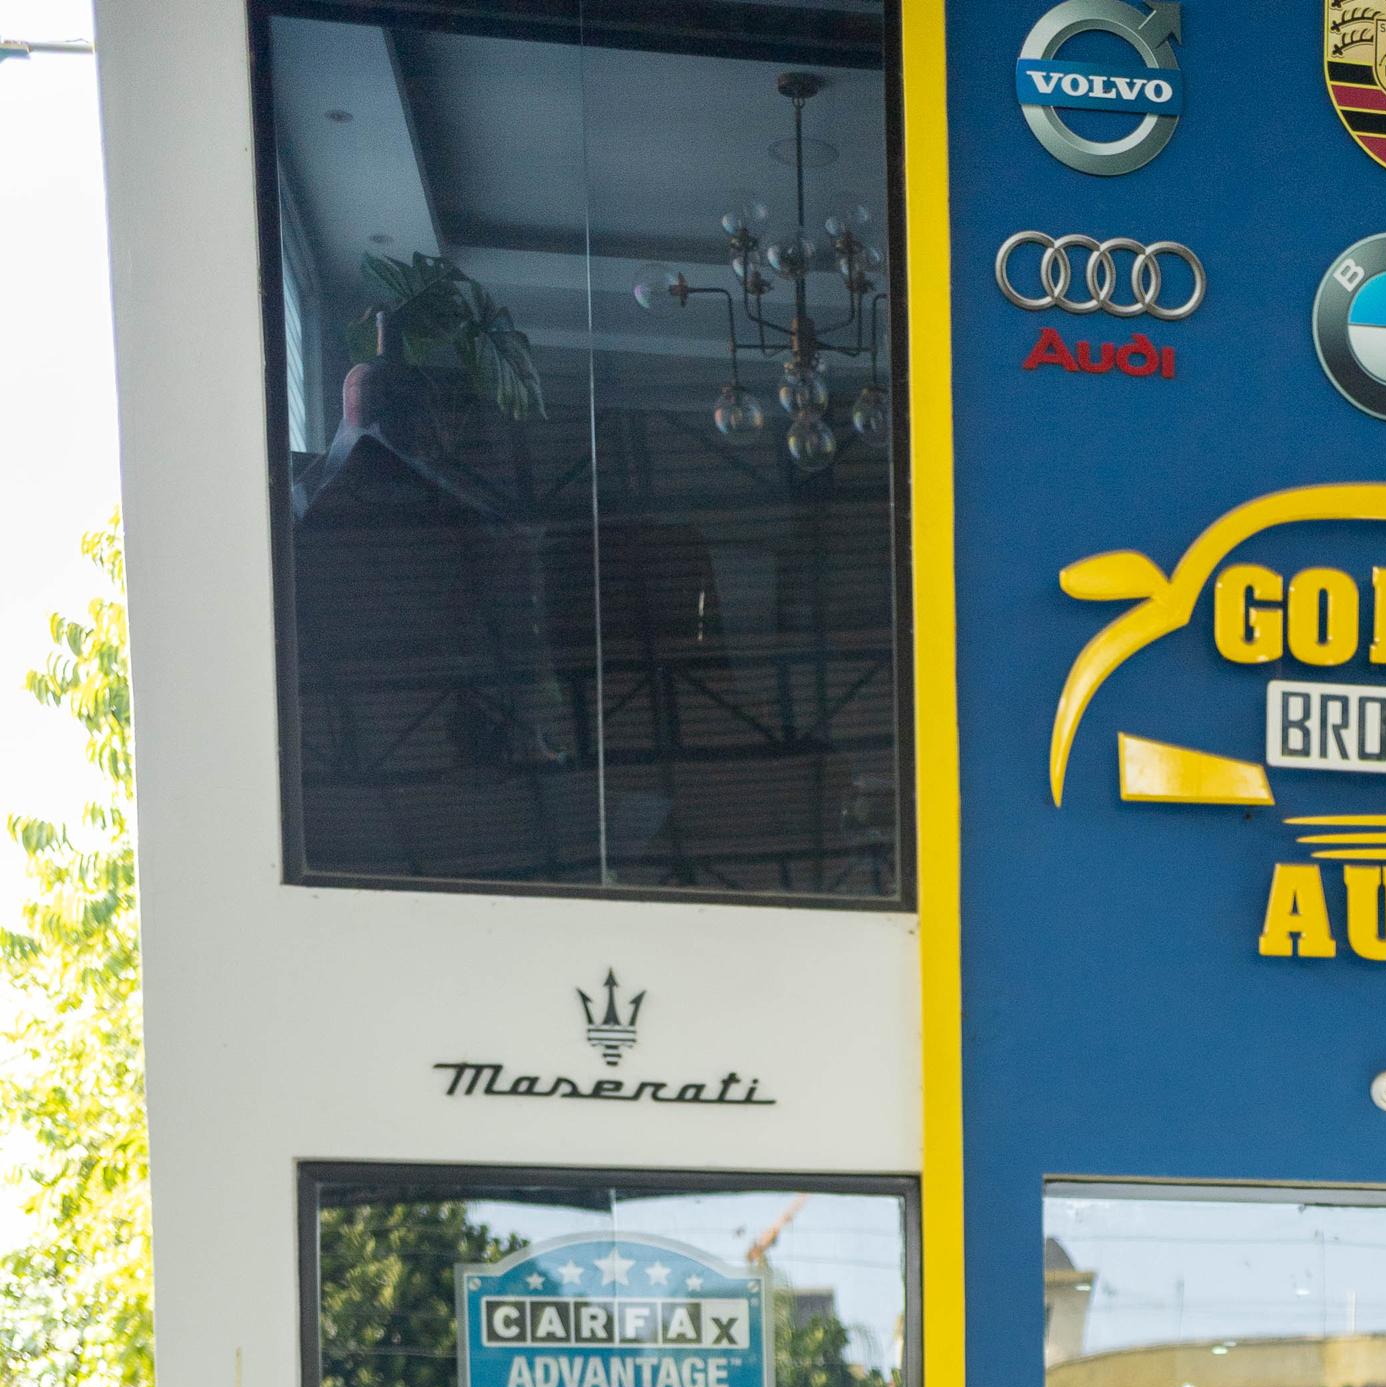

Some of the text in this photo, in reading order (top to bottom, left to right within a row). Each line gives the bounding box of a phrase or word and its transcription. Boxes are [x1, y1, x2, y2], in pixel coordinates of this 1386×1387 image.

[1026, 70, 1173, 103] VOLVO
[1022, 327, 1176, 380] Audi
[433, 1062, 778, 1106] Maserati
[492, 1305, 739, 1345] CARFAX
